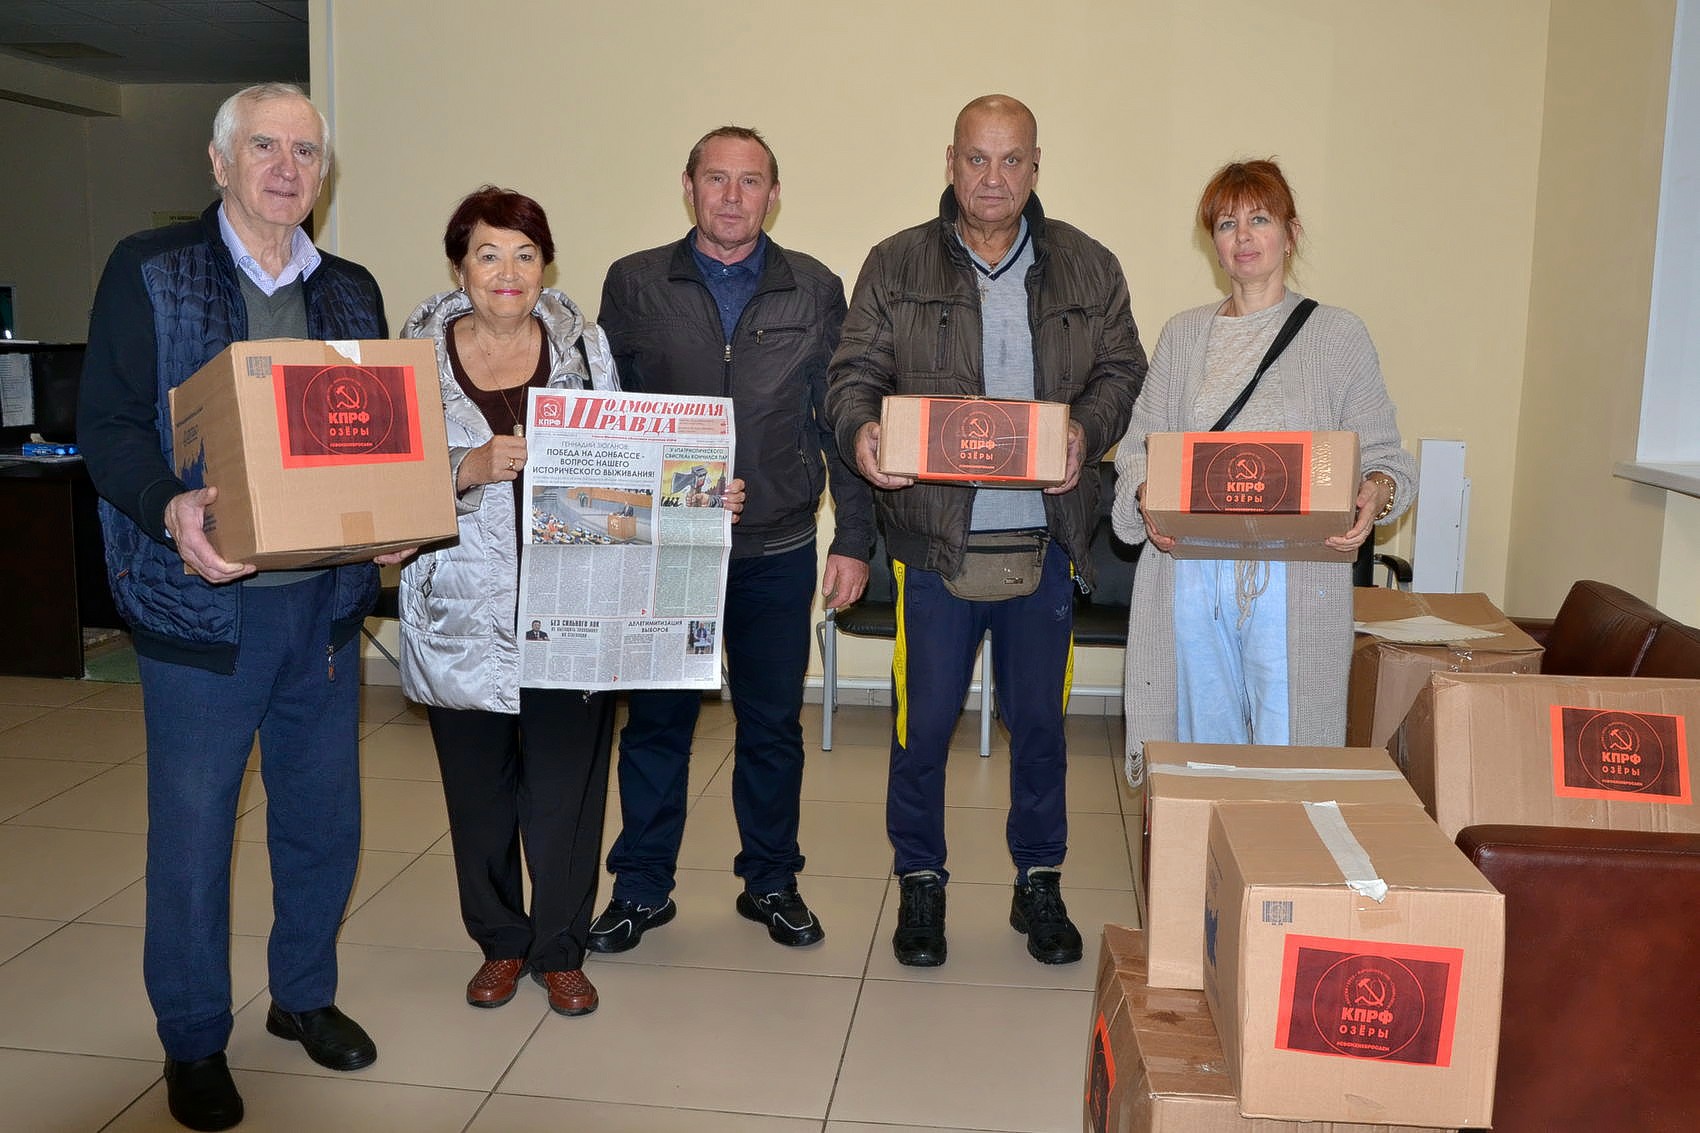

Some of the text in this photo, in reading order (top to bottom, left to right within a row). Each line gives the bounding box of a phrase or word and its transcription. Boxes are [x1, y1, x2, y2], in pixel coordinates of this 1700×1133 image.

[328, 411, 370, 424] КПРФ
[329, 426, 369, 436] ОЗЁРЫ
[960, 439, 995, 450] КПРФ
[546, 448, 579, 457] ПОБЕДА
[581, 450, 593, 458] НА
[594, 450, 640, 459] ДОНБАССЕ
[959, 451, 993, 461] ОЗЁРЫ
[560, 458, 630, 468] ВОПРОС НАШЕГО
[532, 466, 655, 478] ИСТОРИЧЕСКОГО ВЫЖИВАНИЯ!
[1226, 481, 1265, 493] КПРФ
[1226, 494, 1263, 503] ОЗЁРЫ
[1601, 751, 1642, 765] КПРФ
[1602, 765, 1640, 777] ОЗЁРЫ
[1341, 1006, 1394, 1025] КПРФ
[1339, 1024, 1389, 1039] ОЗЁРЫ
